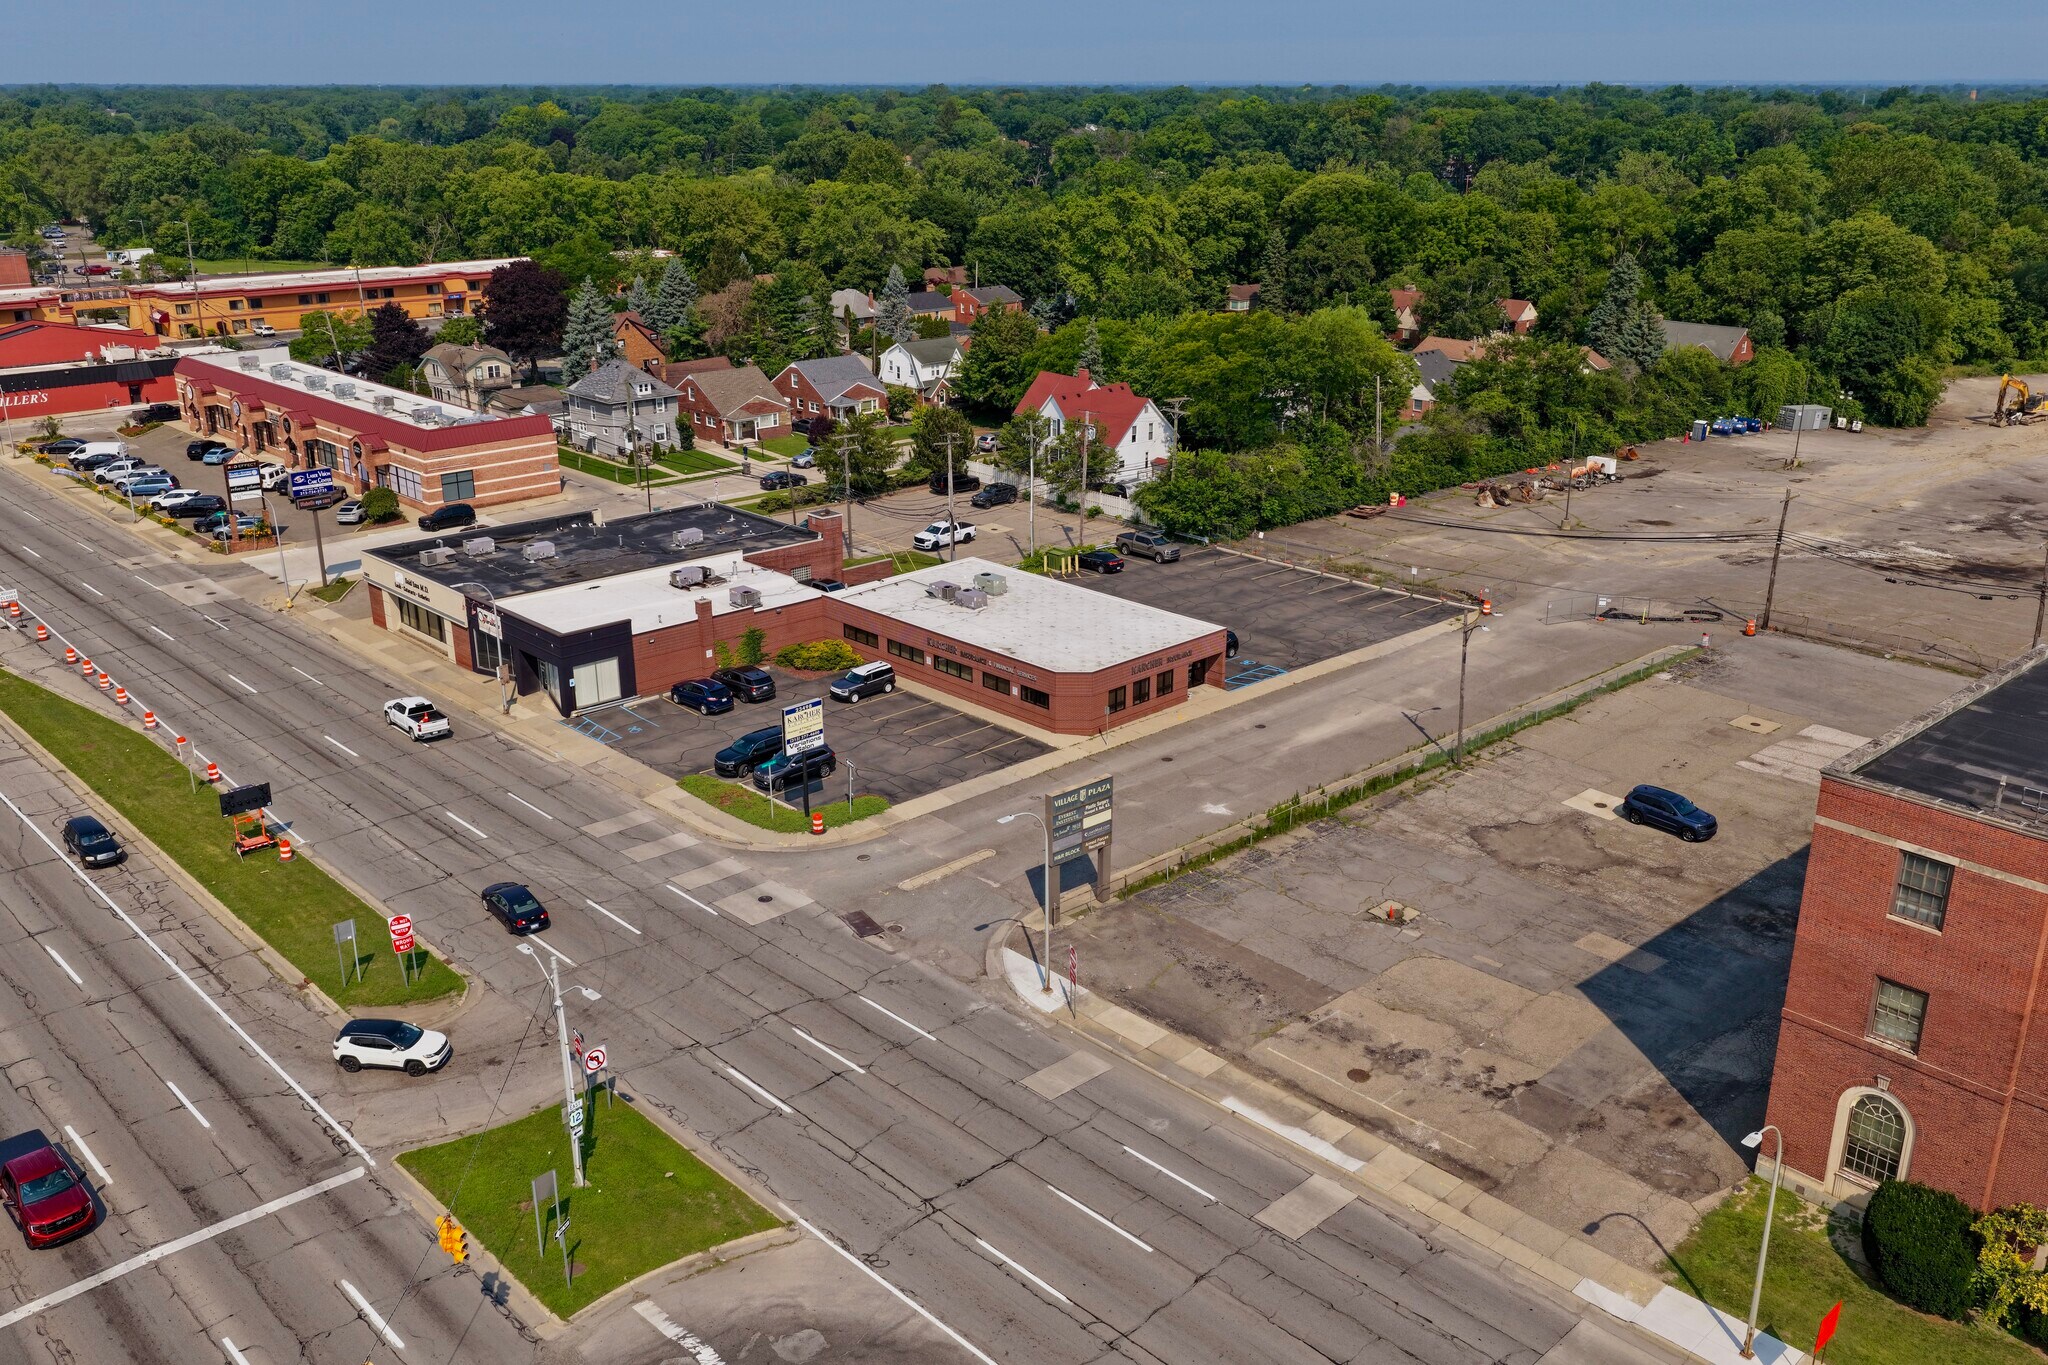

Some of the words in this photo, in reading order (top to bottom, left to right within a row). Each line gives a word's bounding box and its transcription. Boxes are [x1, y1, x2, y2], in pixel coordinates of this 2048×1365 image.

[789, 736, 822, 750] Variations
[796, 743, 814, 752] Salon
[1054, 793, 1078, 807] VILLAGE
[1088, 783, 1110, 796] PLAZA
[395, 936, 412, 946] WRONG
[572, 1112, 581, 1123] 12
